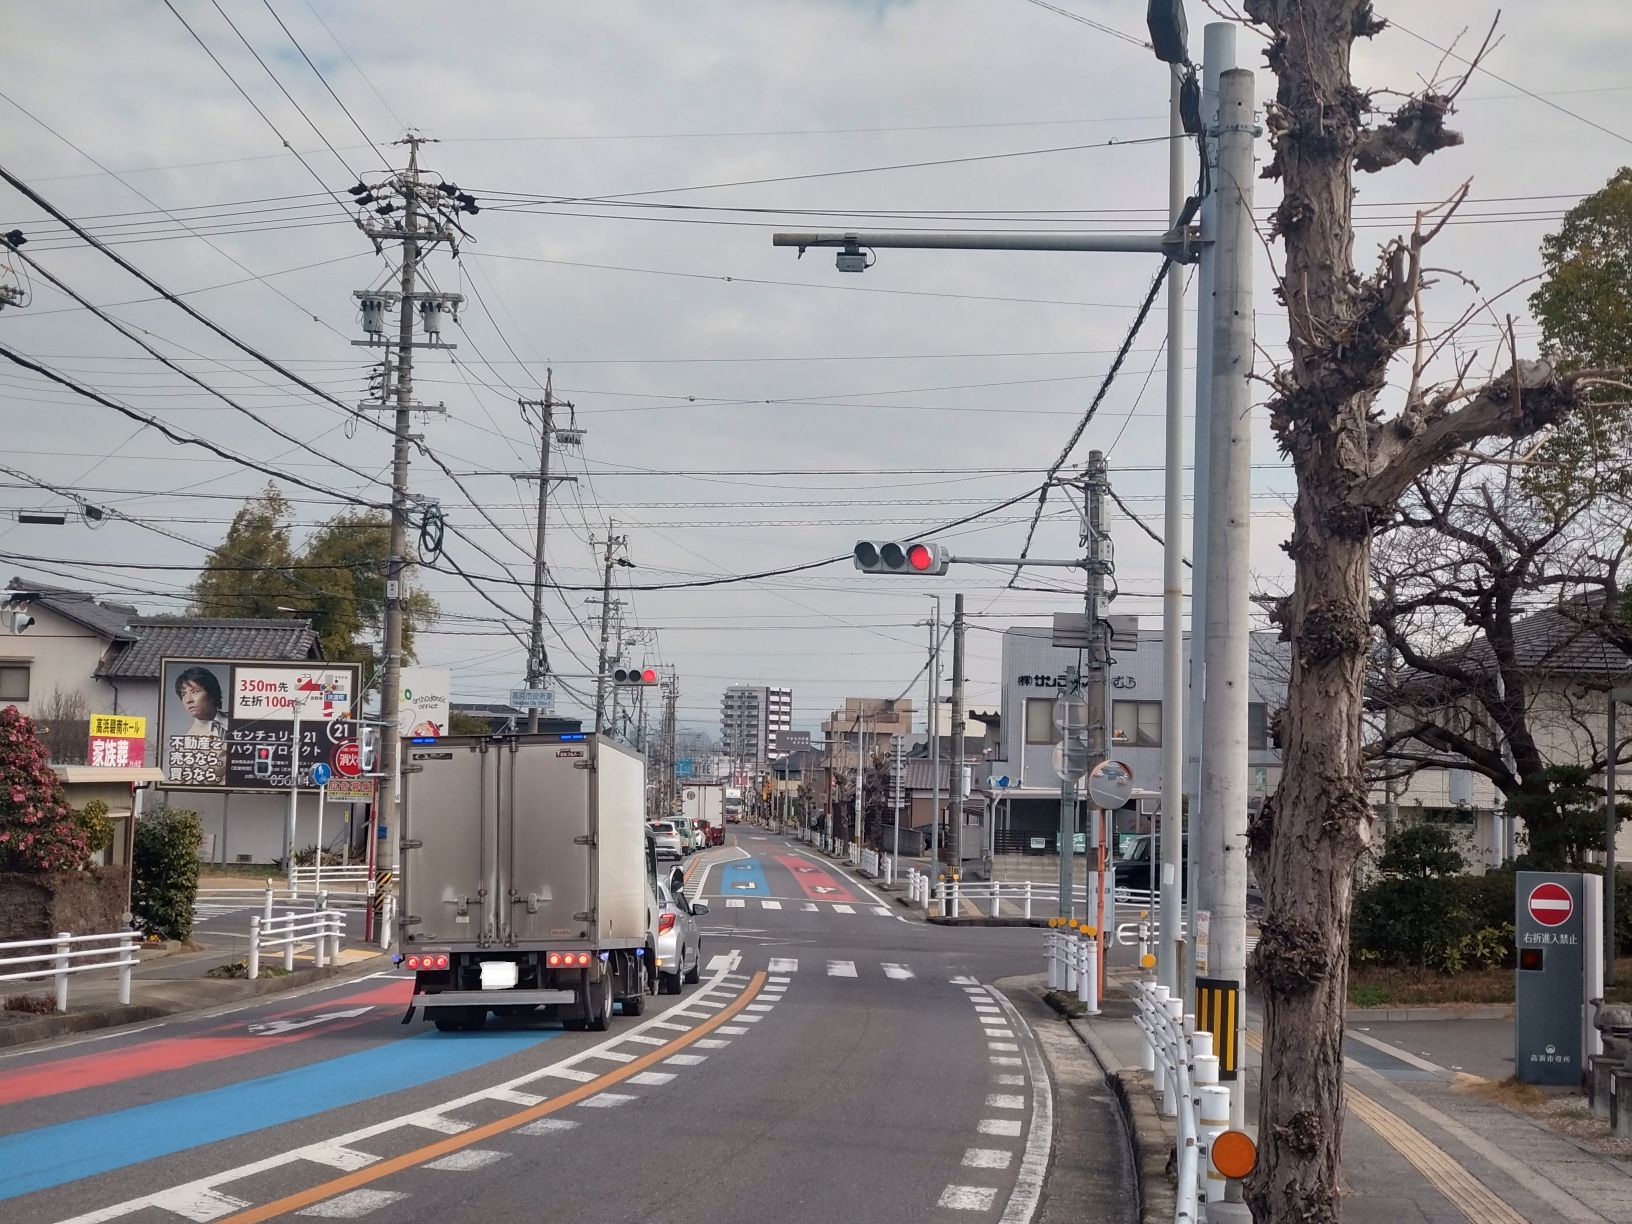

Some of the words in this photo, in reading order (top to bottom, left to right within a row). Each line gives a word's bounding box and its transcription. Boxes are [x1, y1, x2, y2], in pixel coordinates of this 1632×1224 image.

[239, 679, 289, 693] 350m先
[95, 717, 140, 735] 高浜碧南ホール
[333, 723, 349, 737] 21
[170, 735, 222, 751] 不動産を
[91, 738, 129, 767] 家族葬
[170, 751, 222, 767] 売るなら。
[339, 753, 358, 766] 消火
[169, 767, 221, 782] 買うなら。
[1523, 931, 1578, 945] 右折進入禁止
